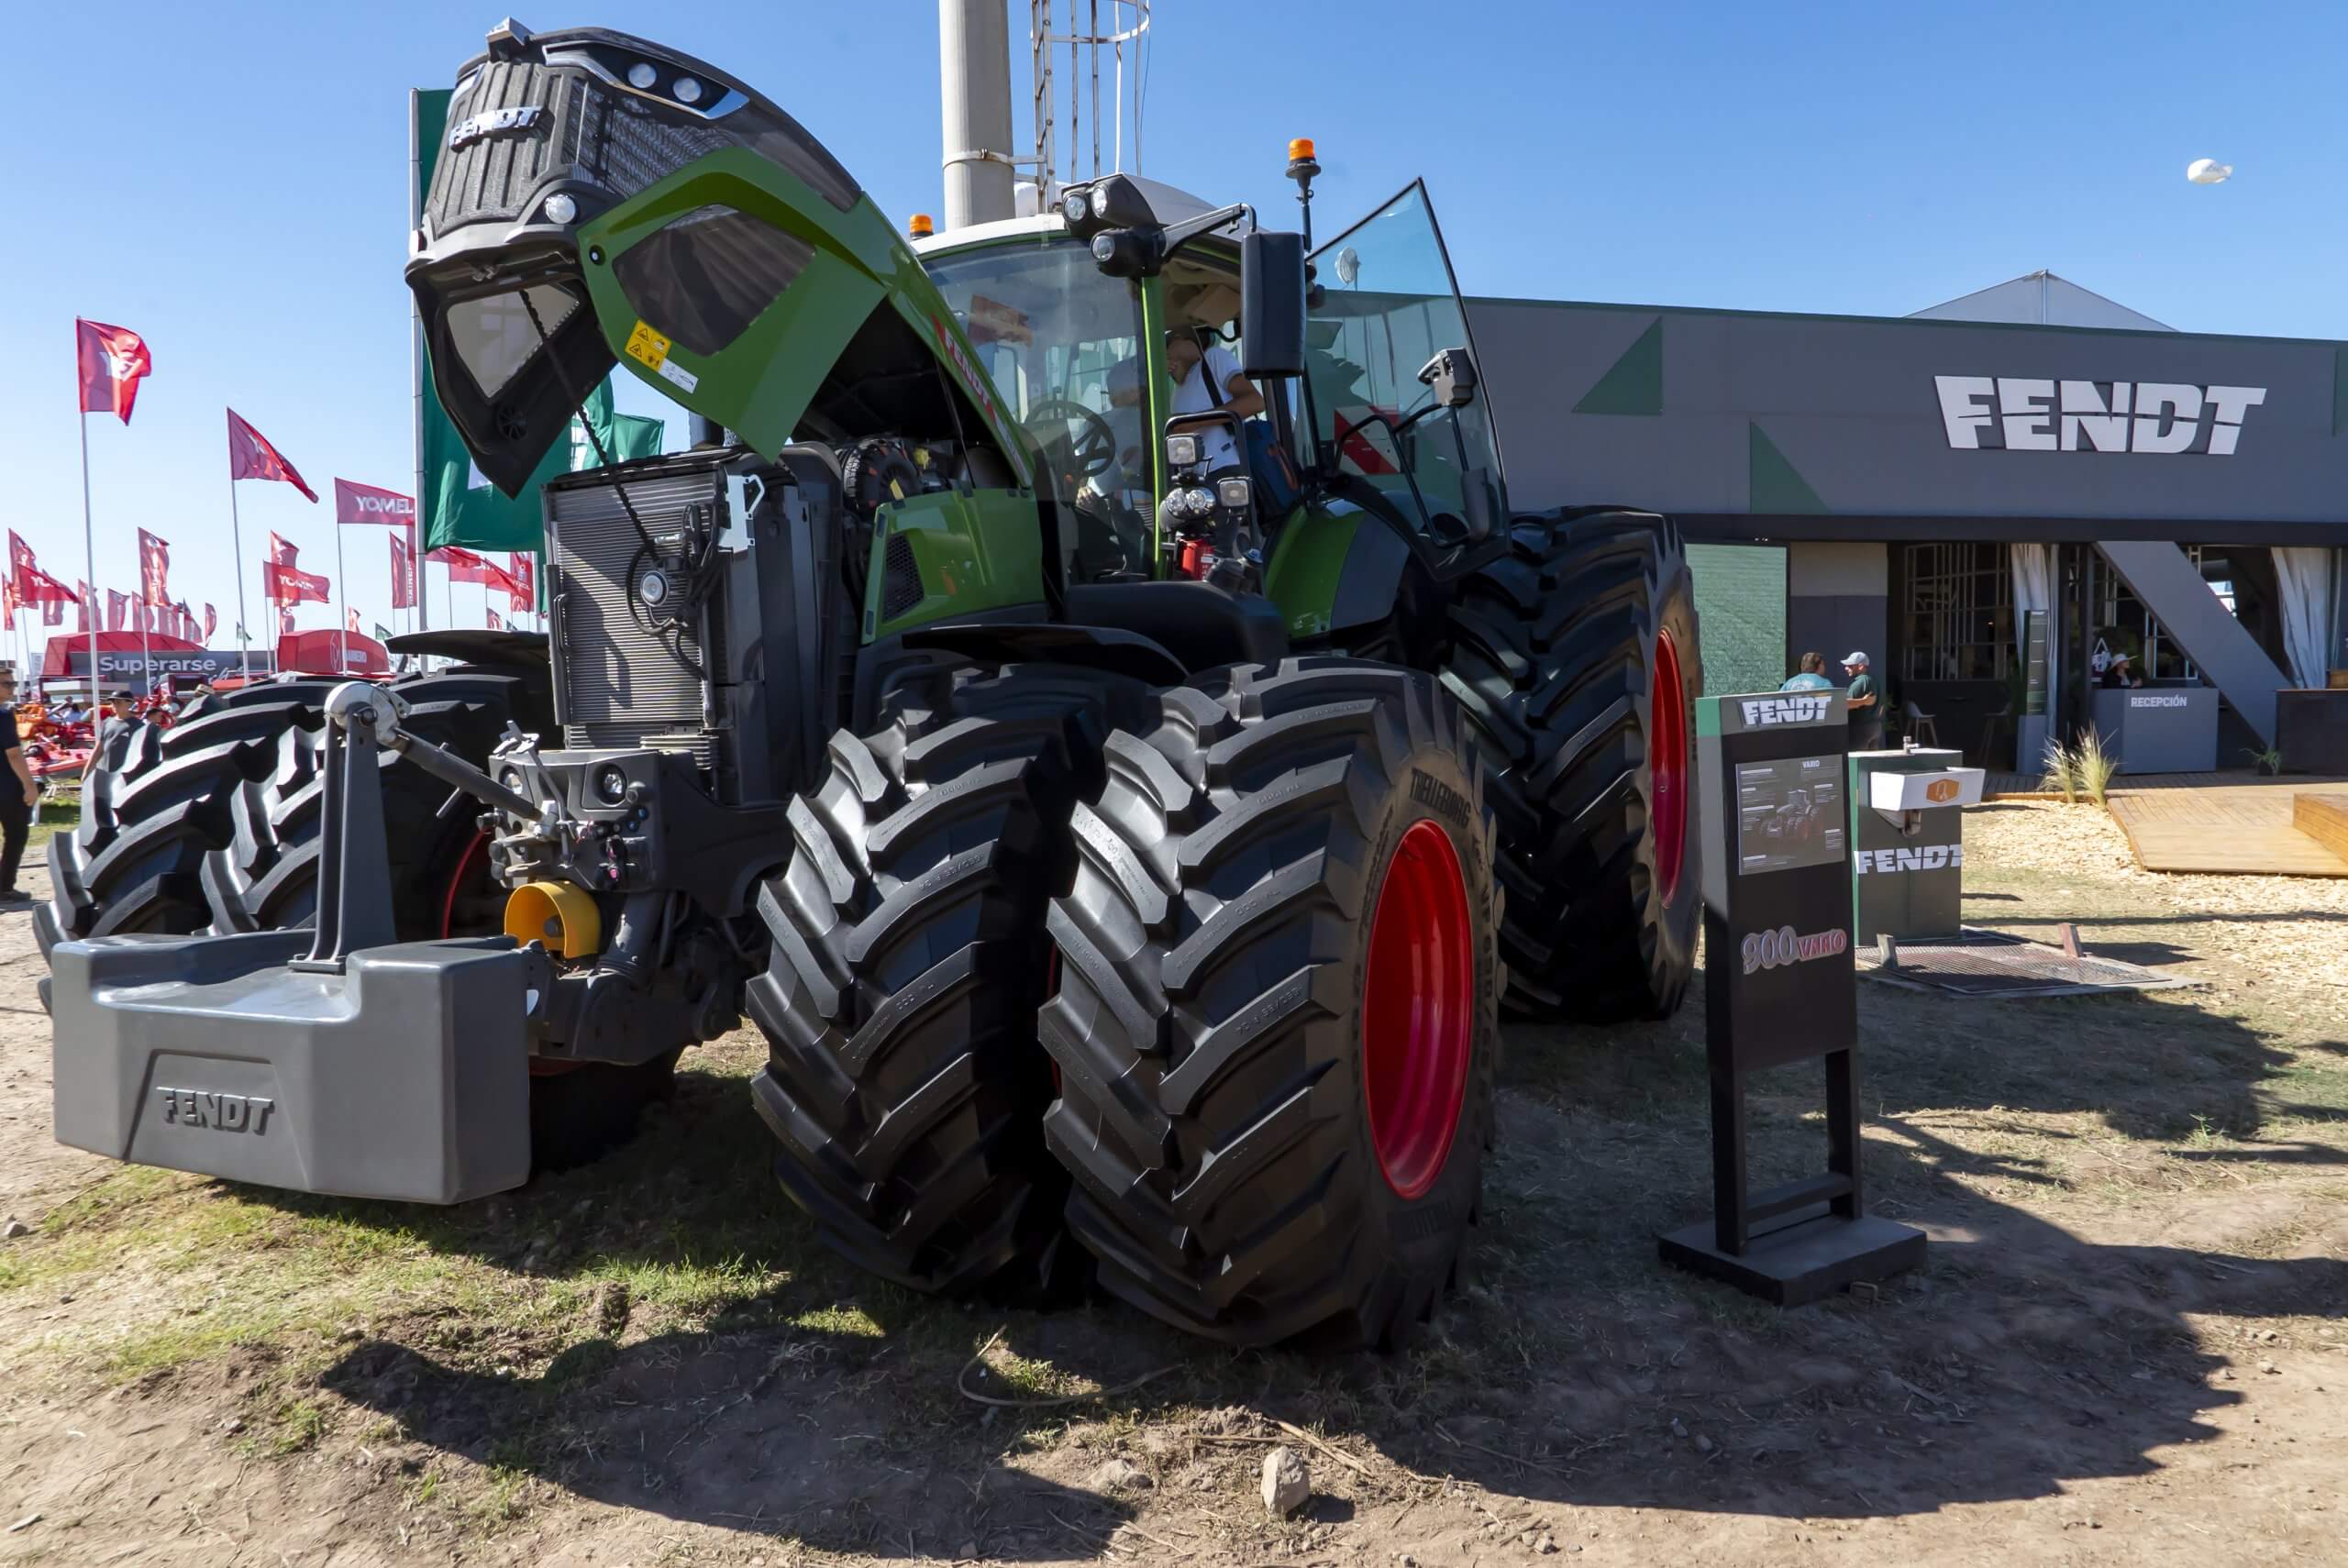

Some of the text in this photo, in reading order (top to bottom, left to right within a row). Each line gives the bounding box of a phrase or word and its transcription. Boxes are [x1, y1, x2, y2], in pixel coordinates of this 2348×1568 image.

[449, 105, 545, 147] FENDT
[1933, 375, 2267, 456] FENDT
[356, 496, 415, 514] YOMEL
[99, 657, 216, 675] Superarse
[1741, 695, 1833, 725] FENDT
[2131, 694, 2187, 707] RECEPCIÓN
[1742, 927, 1846, 974] 900 VARIO
[156, 1087, 274, 1135] FENDT
